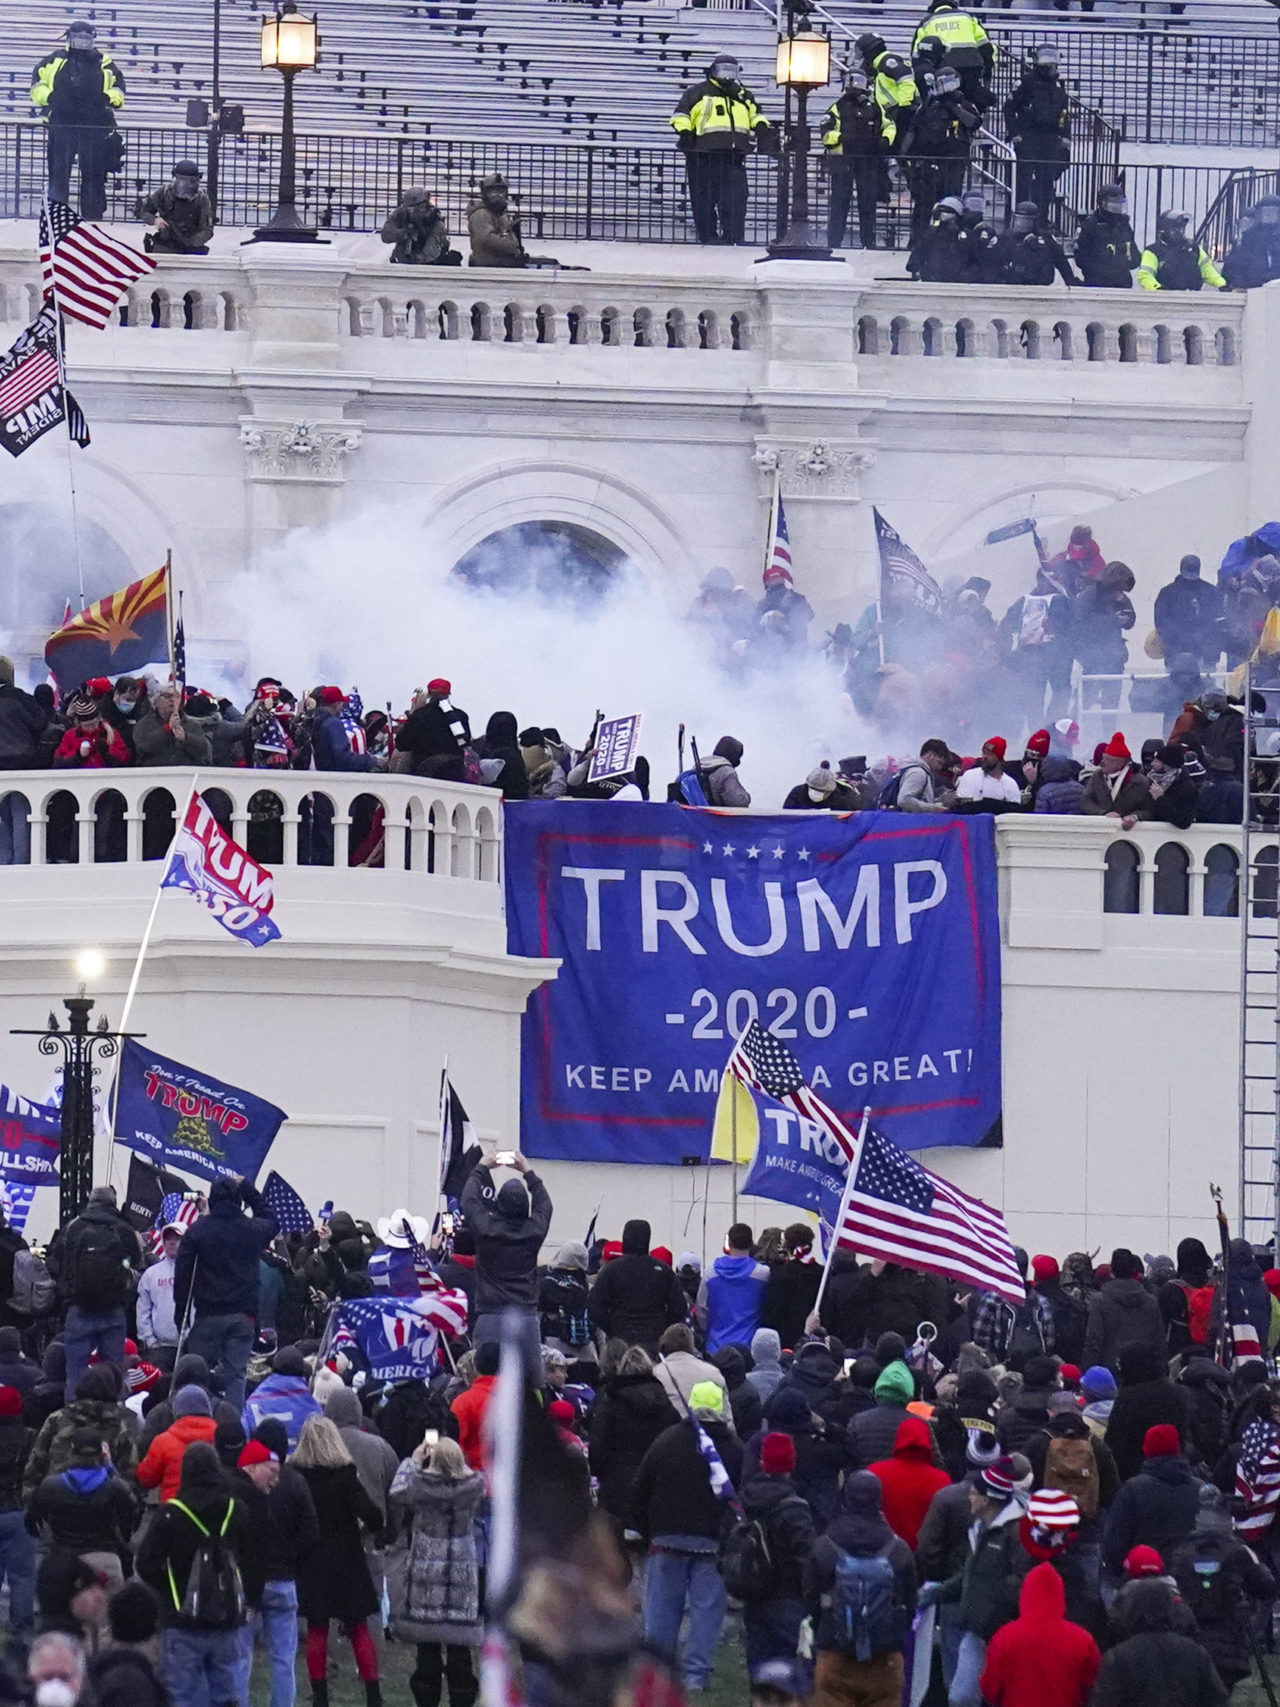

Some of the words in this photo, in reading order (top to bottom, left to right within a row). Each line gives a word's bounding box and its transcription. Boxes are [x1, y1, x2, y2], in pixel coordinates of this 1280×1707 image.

[935, 20, 961, 32] POLICE
[610, 718, 633, 771] TRUMP
[561, 859, 948, 957] TRUMP
[565, 1064, 652, 1092] KEEP
[848, 1048, 974, 1086] GREAT!
[143, 1069, 249, 1136] TRUMP
[134, 1130, 163, 1150] KEEP
[165, 1147, 216, 1172] AMERICA
[765, 1154, 797, 1173] MAKE
